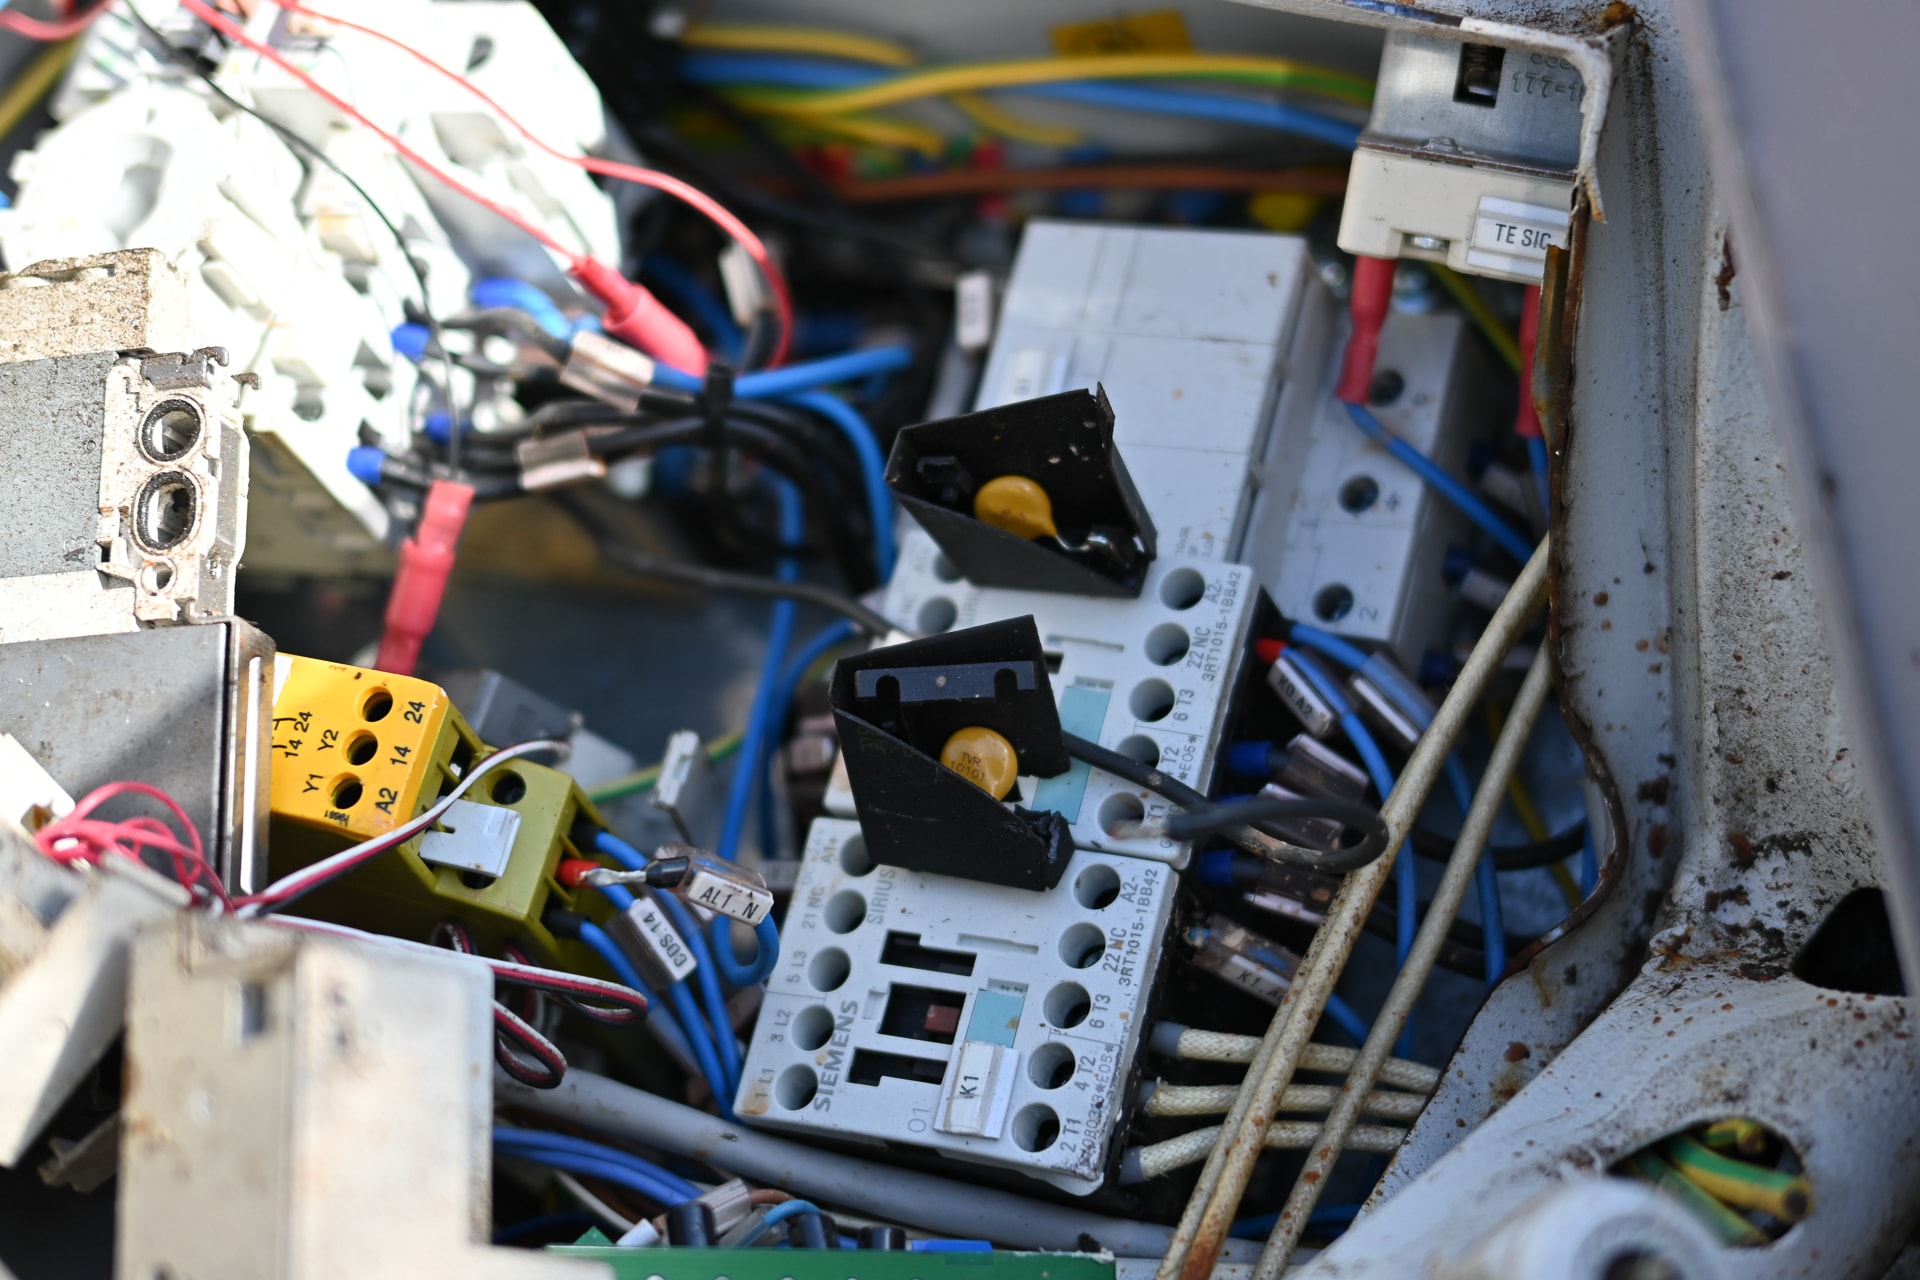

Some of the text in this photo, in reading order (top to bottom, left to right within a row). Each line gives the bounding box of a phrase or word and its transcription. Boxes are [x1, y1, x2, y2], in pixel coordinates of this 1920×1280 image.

[1495, 223, 1517, 244] TE
[1207, 577, 1223, 605] A2-
[1201, 571, 1242, 682] 3RT1015-1BB42
[1186, 626, 1210, 669] 22 NC
[404, 700, 426, 724] 24
[1173, 688, 1195, 722] 6 T3
[294, 711, 313, 733] 24
[284, 739, 303, 758] 14
[317, 729, 339, 752] Y2
[390, 745, 412, 766] 14
[962, 752, 982, 768] TVR
[1161, 745, 1180, 766] T2
[302, 773, 324, 793] Y1
[375, 787, 399, 815] A2
[867, 868, 896, 926] SIRIUS
[1120, 876, 1139, 903] A2-
[802, 914, 818, 930] 21
[1118, 868, 1158, 987] 3RT1015-1BB42
[1102, 927, 1127, 973] 22 NC
[786, 950, 808, 984] 5 L3
[1089, 993, 1111, 1029] 6 T3
[770, 1009, 792, 1043] 3 L2
[813, 999, 859, 1113] SIEMENS
[758, 1067, 775, 1085] L1
[959, 1074, 980, 1100] K1
[1074, 1055, 1096, 1092] 4 T2
[1060, 1117, 1081, 1153] 2 T1
